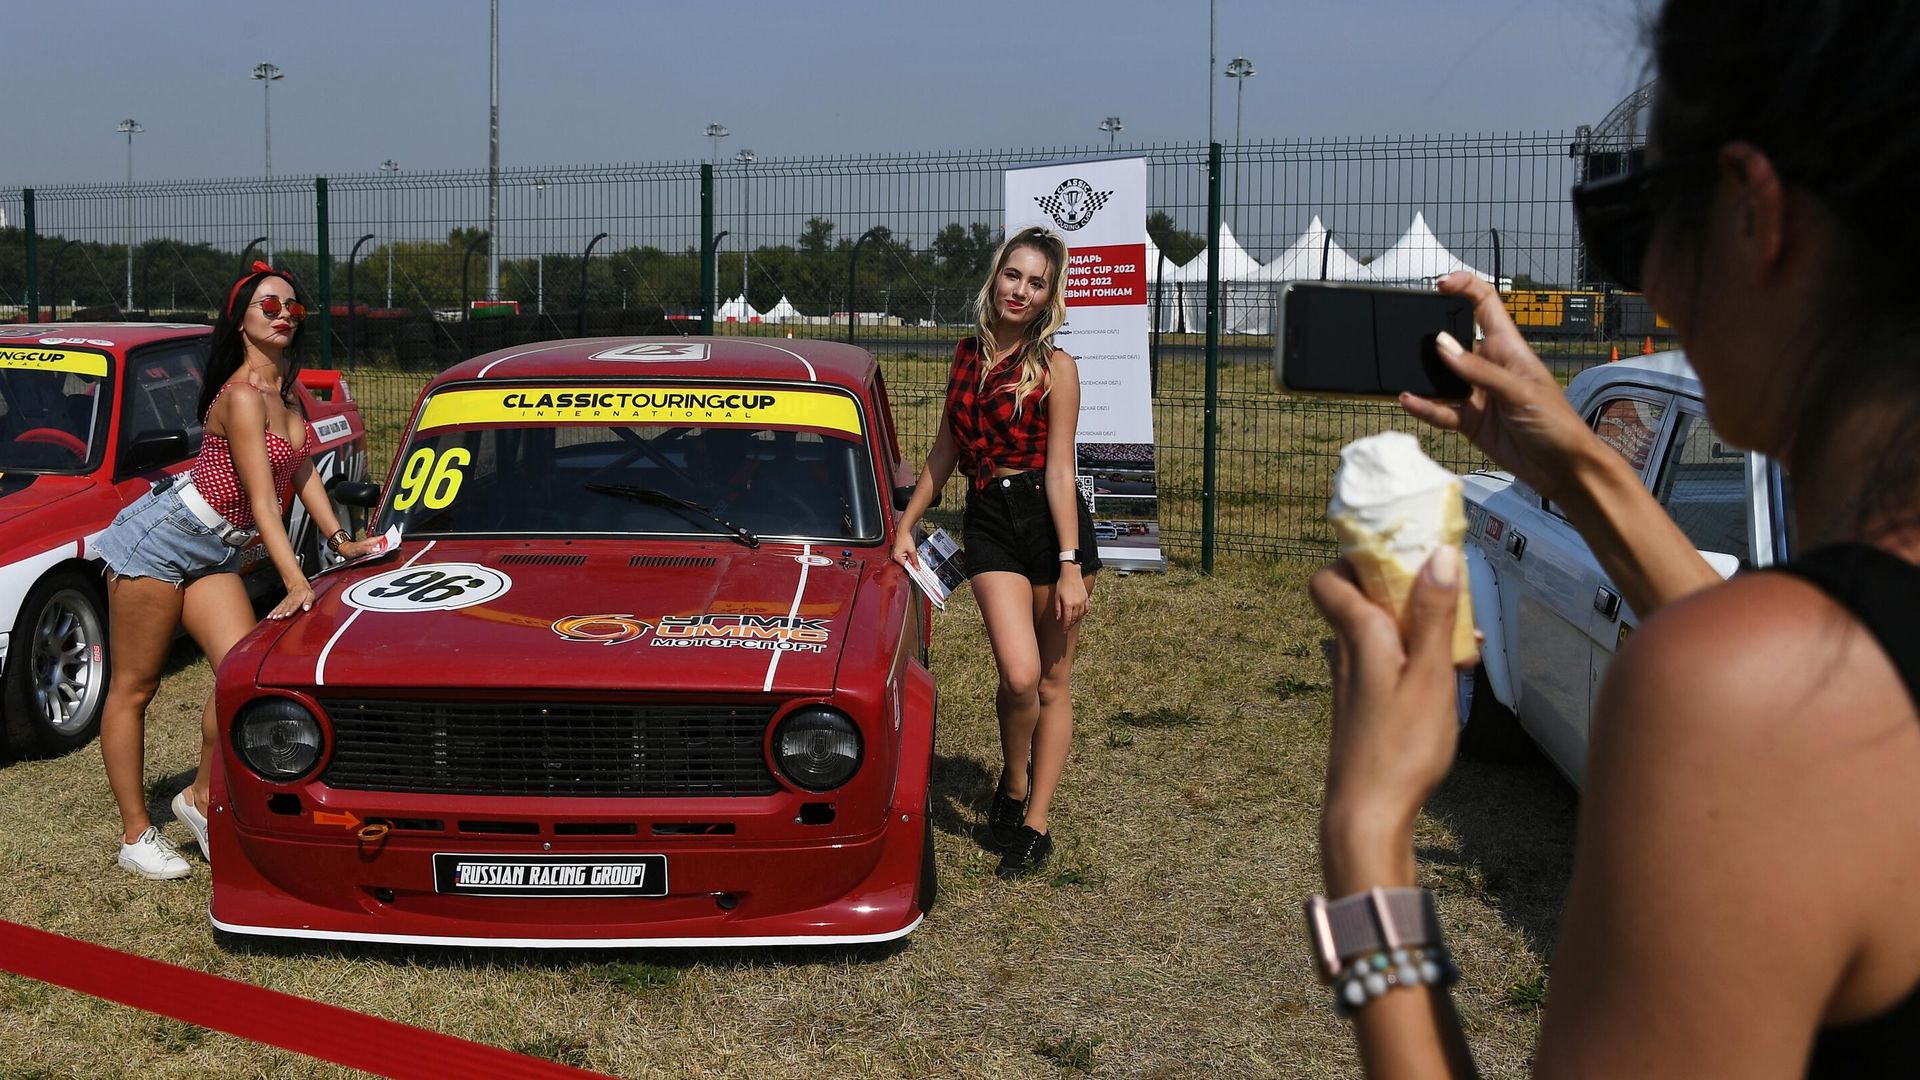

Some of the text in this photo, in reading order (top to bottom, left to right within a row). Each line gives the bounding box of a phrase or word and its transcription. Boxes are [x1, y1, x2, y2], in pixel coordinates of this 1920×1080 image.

[1057, 179, 1090, 194] CLASSIC
[1054, 210, 1092, 230] TOURING CUP
[1067, 264, 1136, 275] RING CUP 2022
[1090, 277, 1112, 286] 2022
[1092, 287, 1132, 297] ГОНКАМ
[393, 447, 471, 511] 96
[367, 570, 485, 603] 96
[662, 614, 832, 632] УГМК
[650, 638, 827, 653] МОТОРСПОРТ
[460, 866, 642, 885] RUSSIAN RACING GROUP
